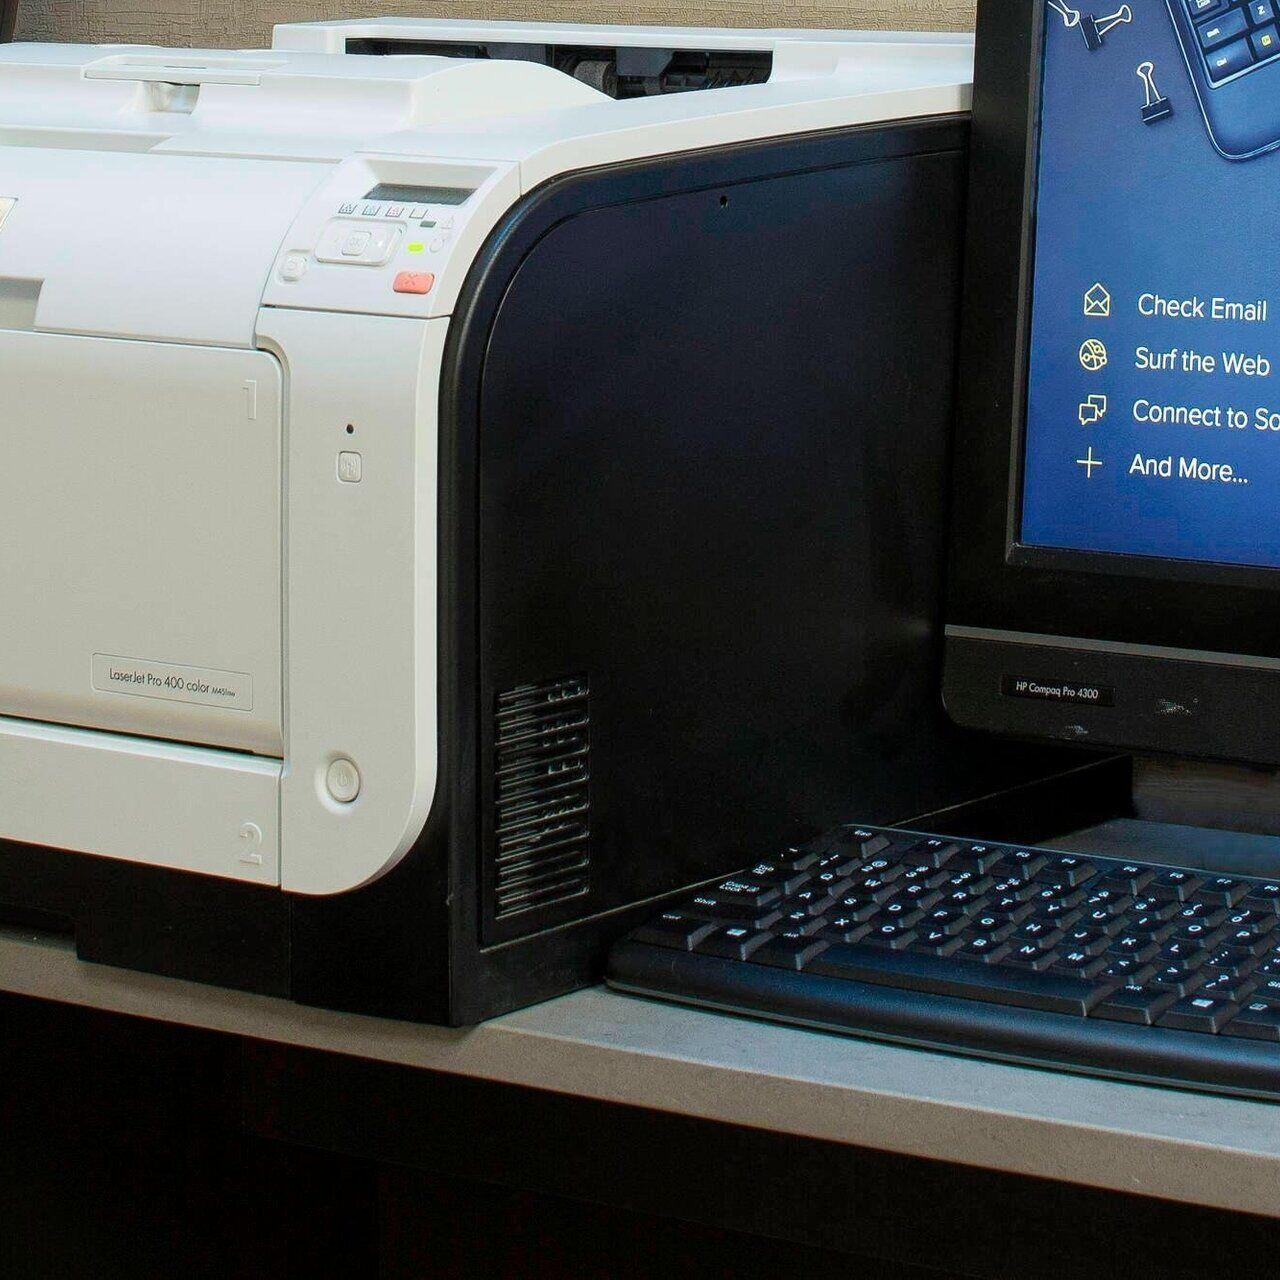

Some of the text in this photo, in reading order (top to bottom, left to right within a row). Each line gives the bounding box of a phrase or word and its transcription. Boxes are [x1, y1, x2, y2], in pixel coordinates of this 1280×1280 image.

[1258, 6, 1265, 15] Z
[1137, 293, 1268, 322] Check Email
[1134, 346, 1271, 377] Surf the Web
[1132, 400, 1221, 428] Connect
[1226, 407, 1248, 429] to
[1128, 453, 1249, 484] And More...
[109, 667, 145, 685] LaserJet
[147, 673, 162, 687] Pro
[164, 676, 185, 690] 400
[186, 679, 211, 694] color
[1016, 681, 1099, 699] HP Compaq Pro 4300
